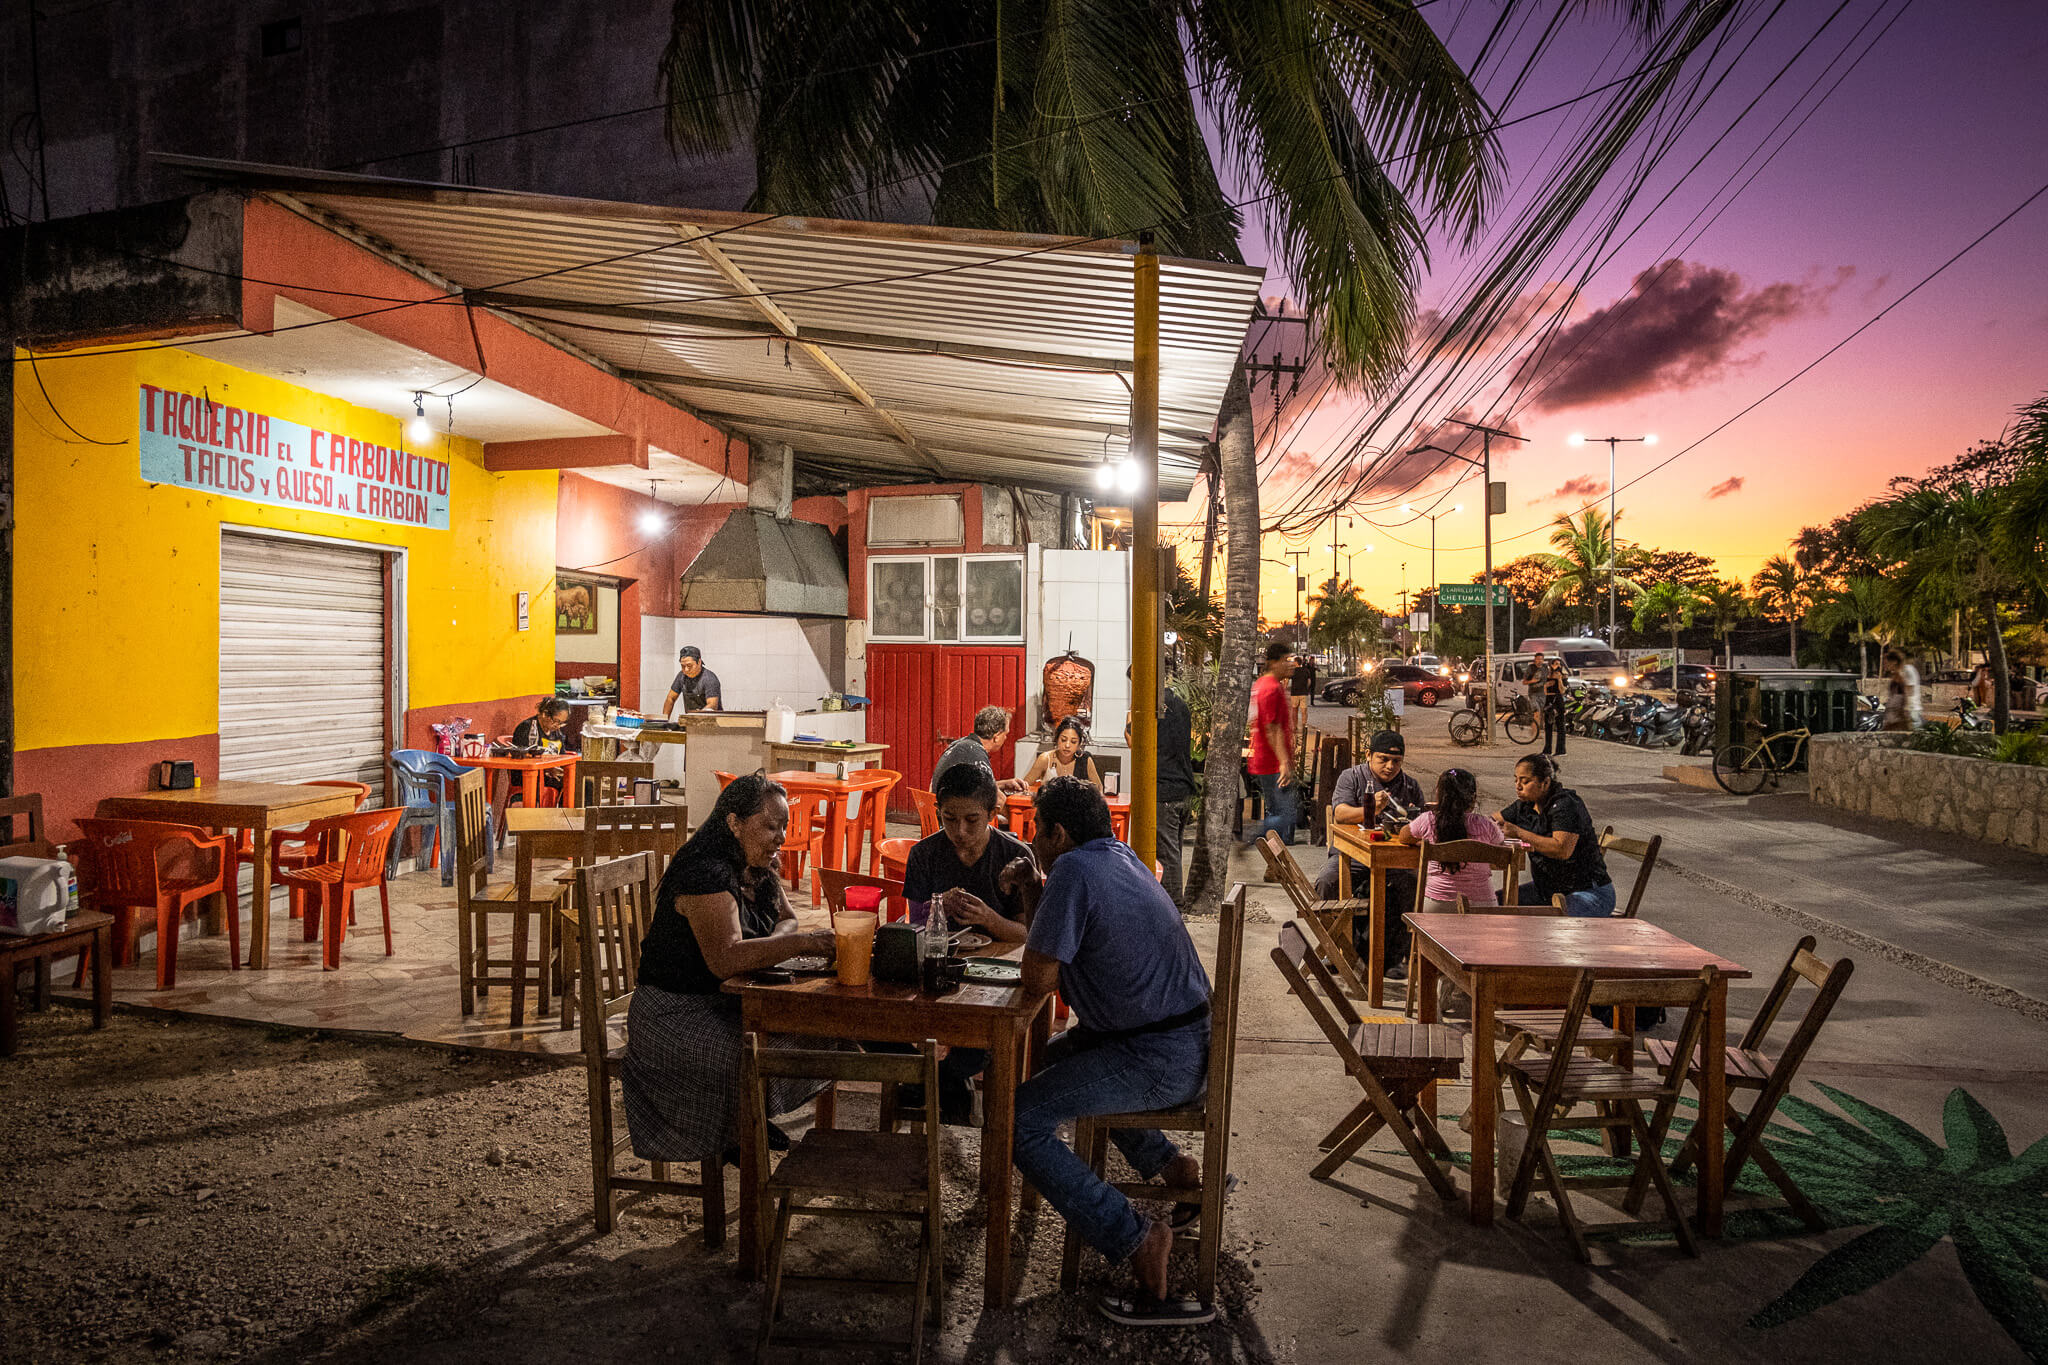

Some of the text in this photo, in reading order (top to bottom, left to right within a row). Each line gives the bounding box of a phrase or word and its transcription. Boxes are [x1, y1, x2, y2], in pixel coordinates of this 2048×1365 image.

[140, 383, 448, 496] TAQUERIA EL CARBONCITO
[178, 443, 255, 493] TACOS
[276, 466, 333, 507] QUESO
[338, 493, 350, 511] AL
[356, 482, 428, 524] CARBON
[1440, 594, 1485, 602] CHETUMAL
